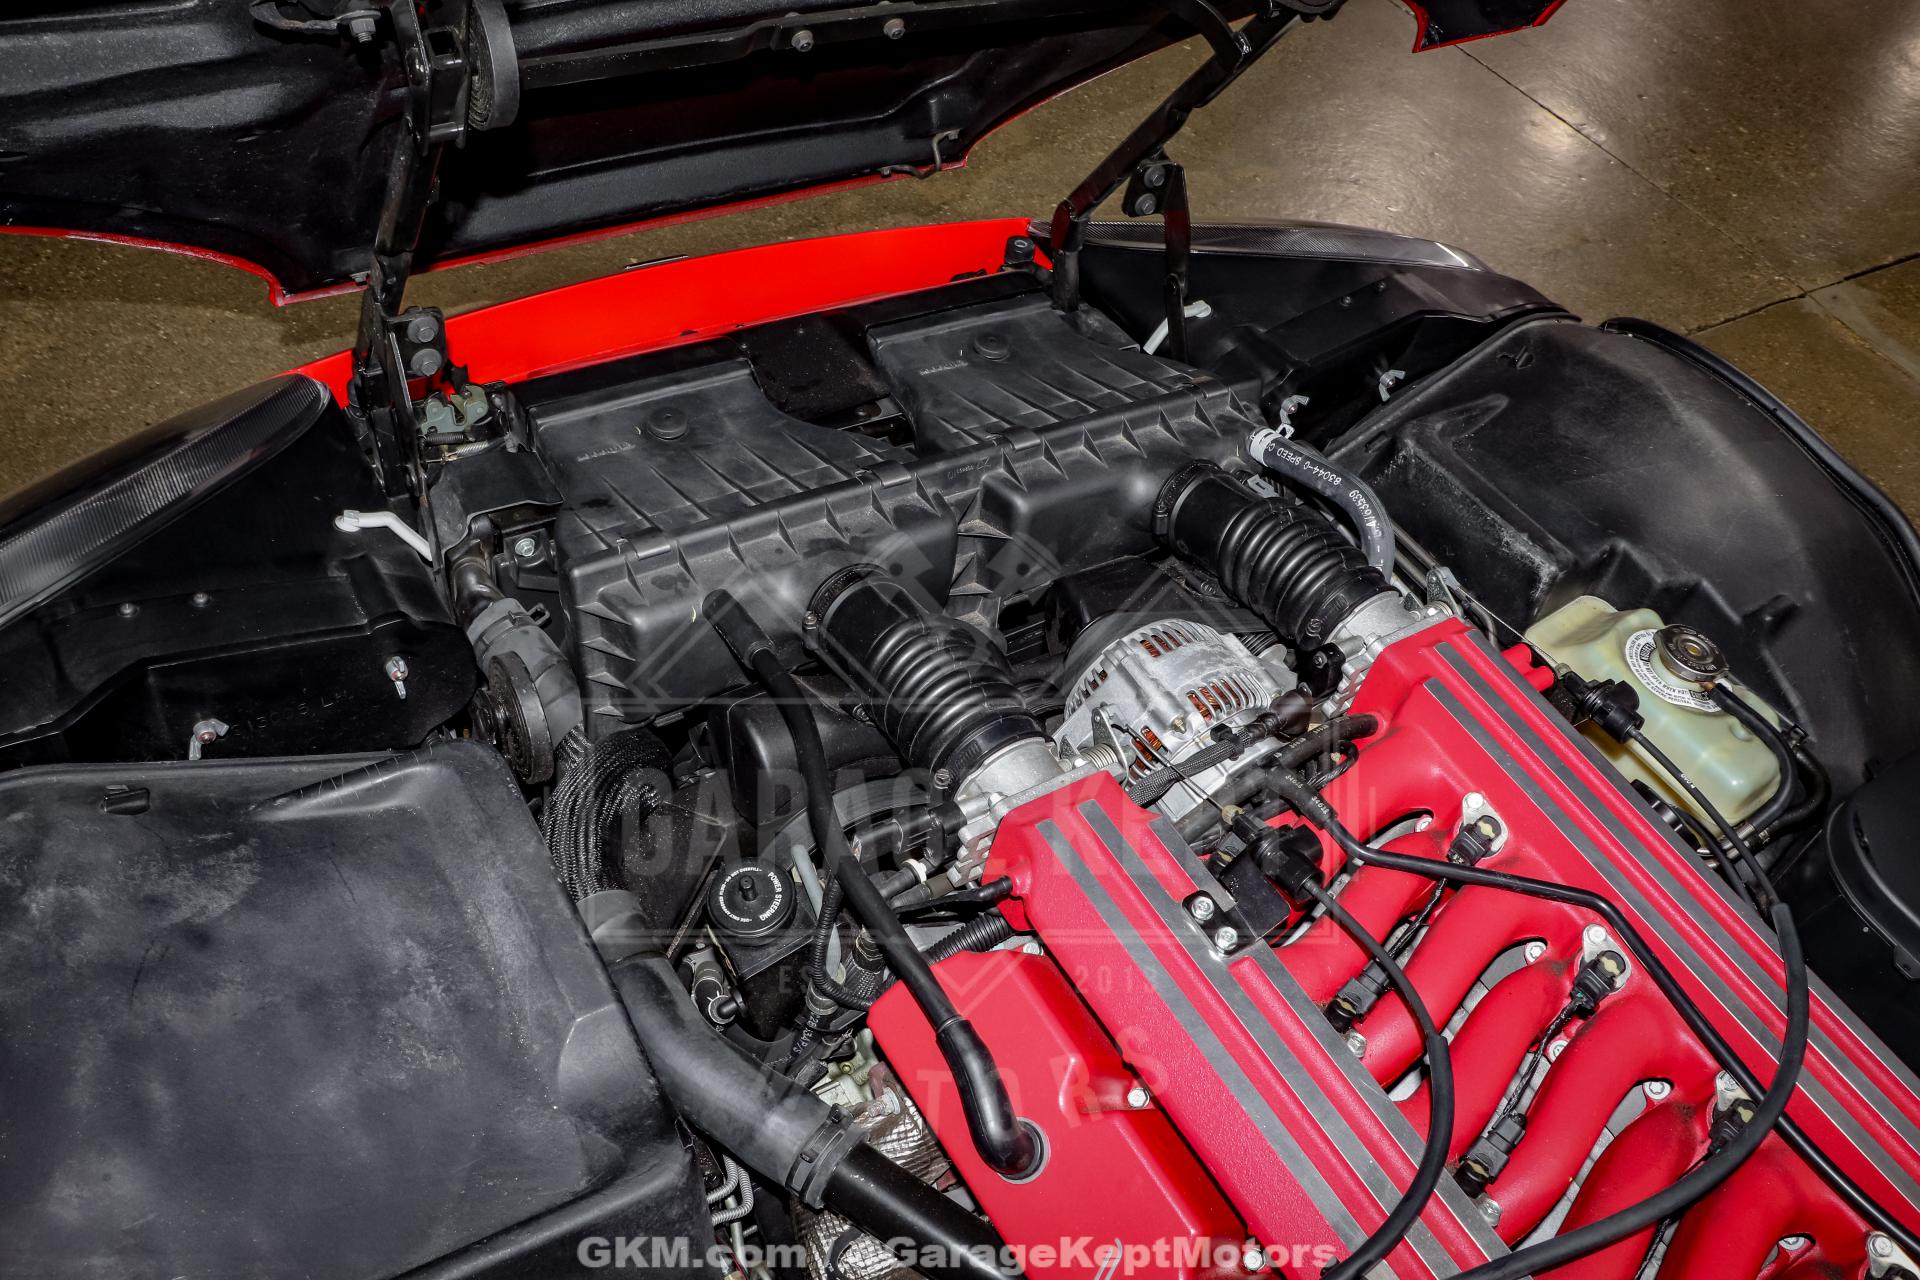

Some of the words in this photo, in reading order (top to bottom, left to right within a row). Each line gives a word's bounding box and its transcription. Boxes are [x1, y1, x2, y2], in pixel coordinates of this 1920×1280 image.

[1277, 448, 1302, 465] SPEED
[767, 871, 783, 893] POWER
[759, 894, 783, 921] STEERING
